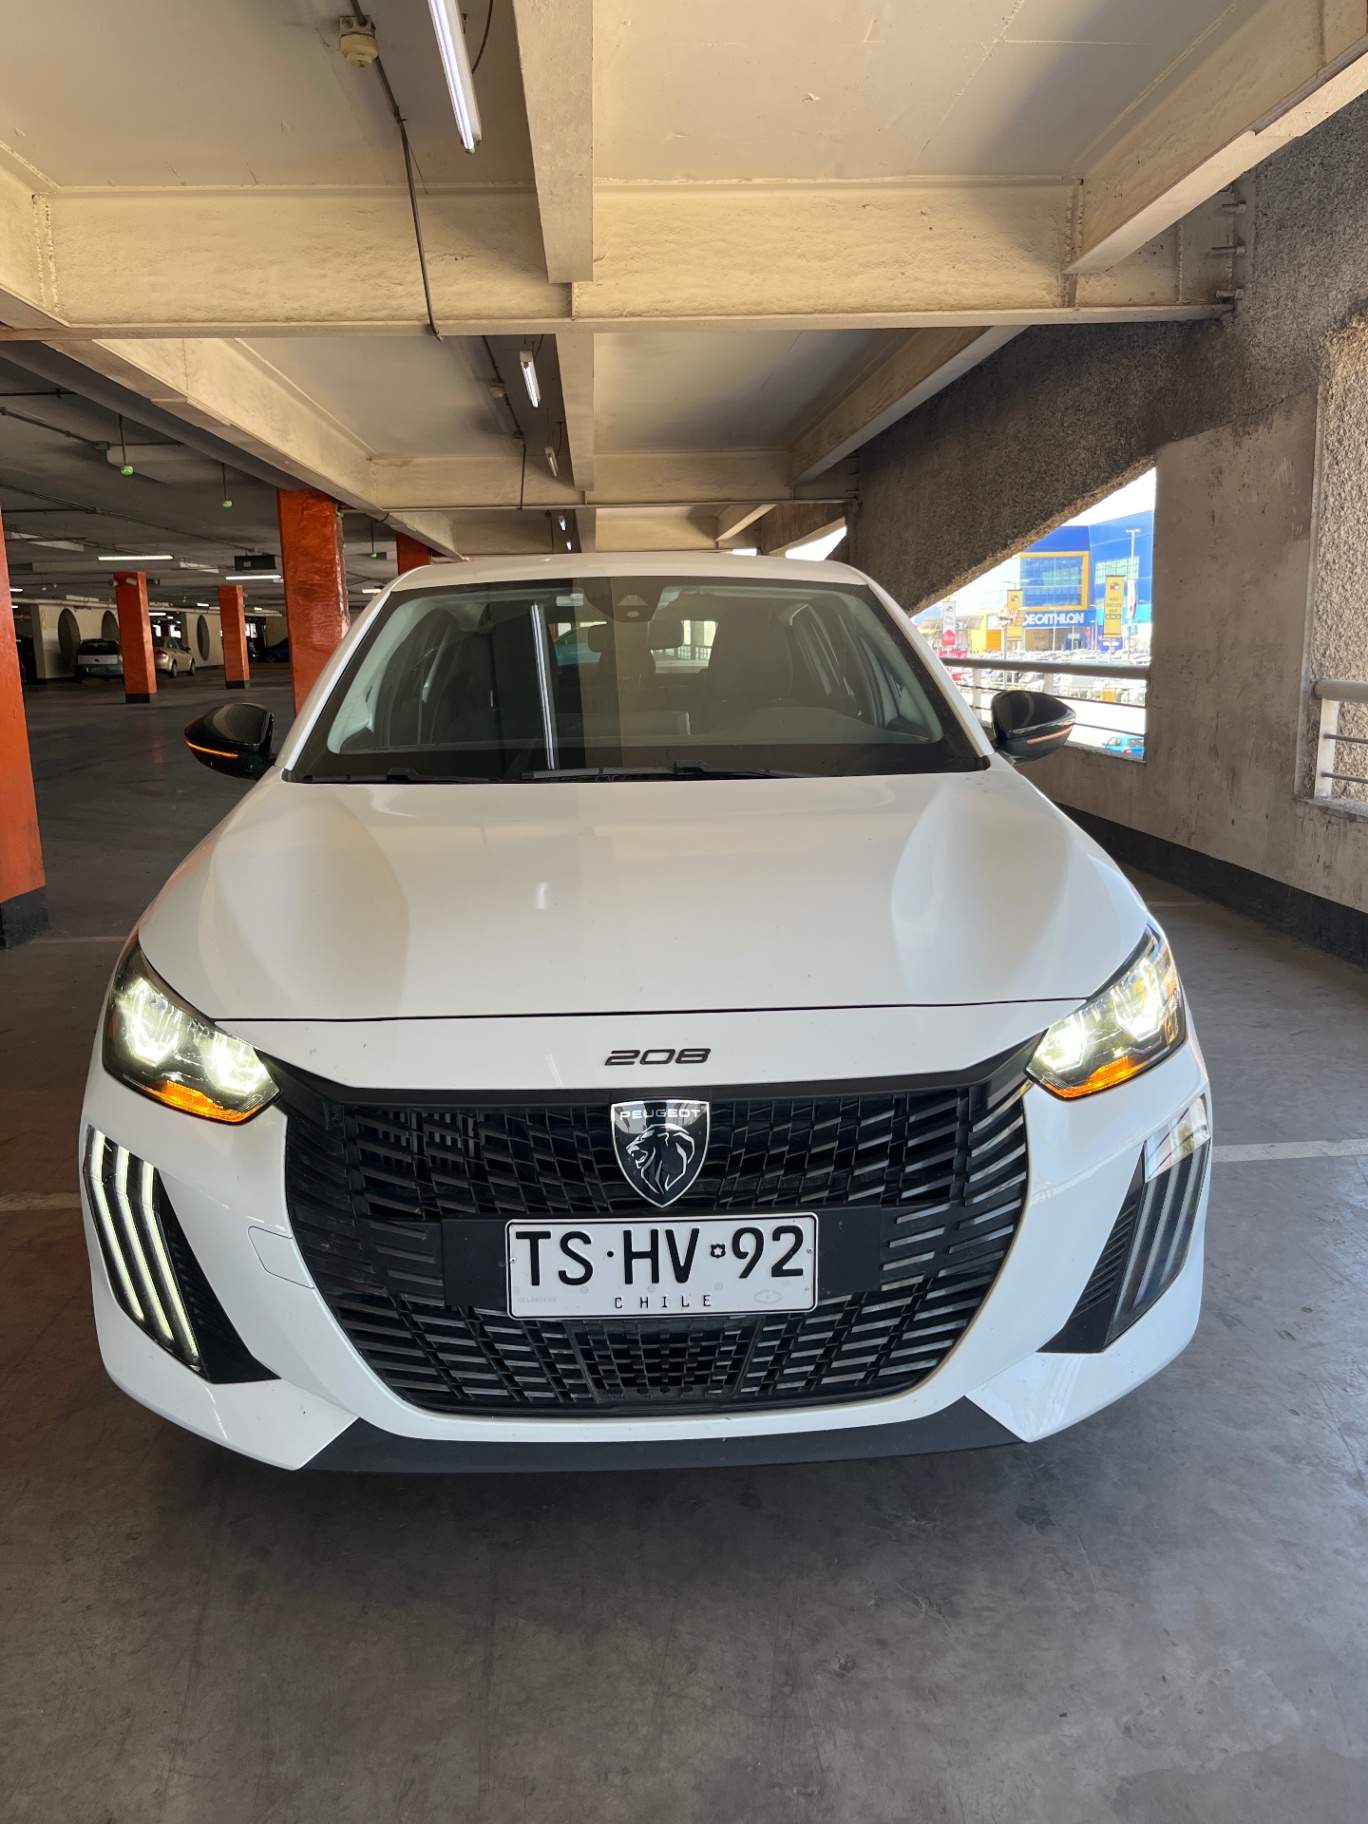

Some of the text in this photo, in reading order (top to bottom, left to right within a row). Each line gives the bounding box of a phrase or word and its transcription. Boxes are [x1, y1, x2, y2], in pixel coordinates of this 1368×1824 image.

[604, 1048, 712, 1066] 208
[619, 1108, 701, 1120] PEUGEOT
[614, 1294, 713, 1309] CHILE
